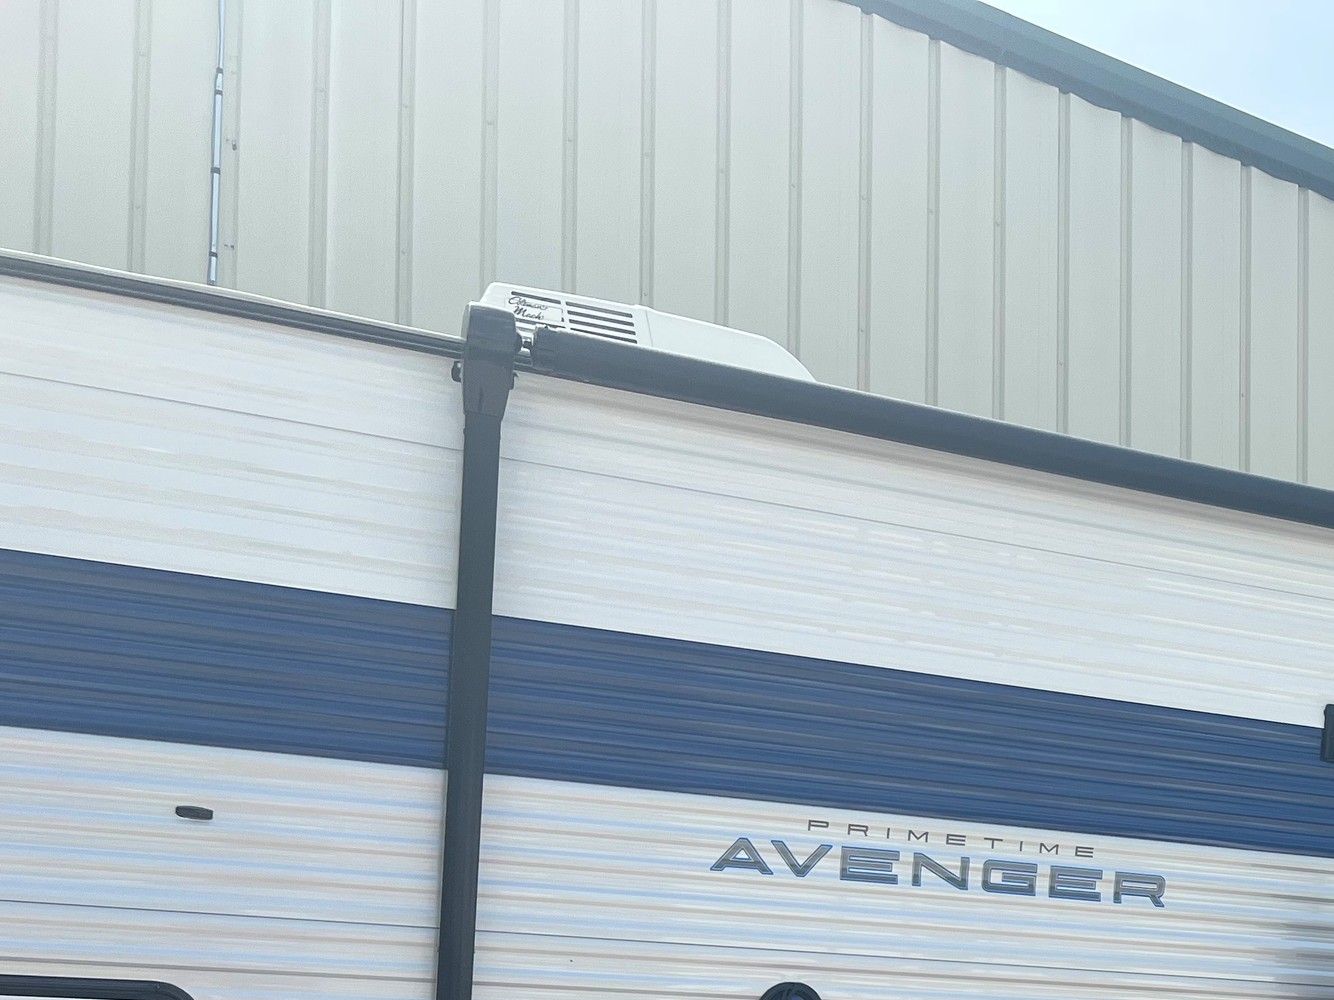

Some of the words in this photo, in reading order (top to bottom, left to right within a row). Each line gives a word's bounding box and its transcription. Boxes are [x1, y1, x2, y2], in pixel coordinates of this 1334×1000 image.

[513, 305, 544, 320] Mach
[808, 819, 1094, 859] PRIMETIME
[709, 837, 1167, 908] AVENGER
